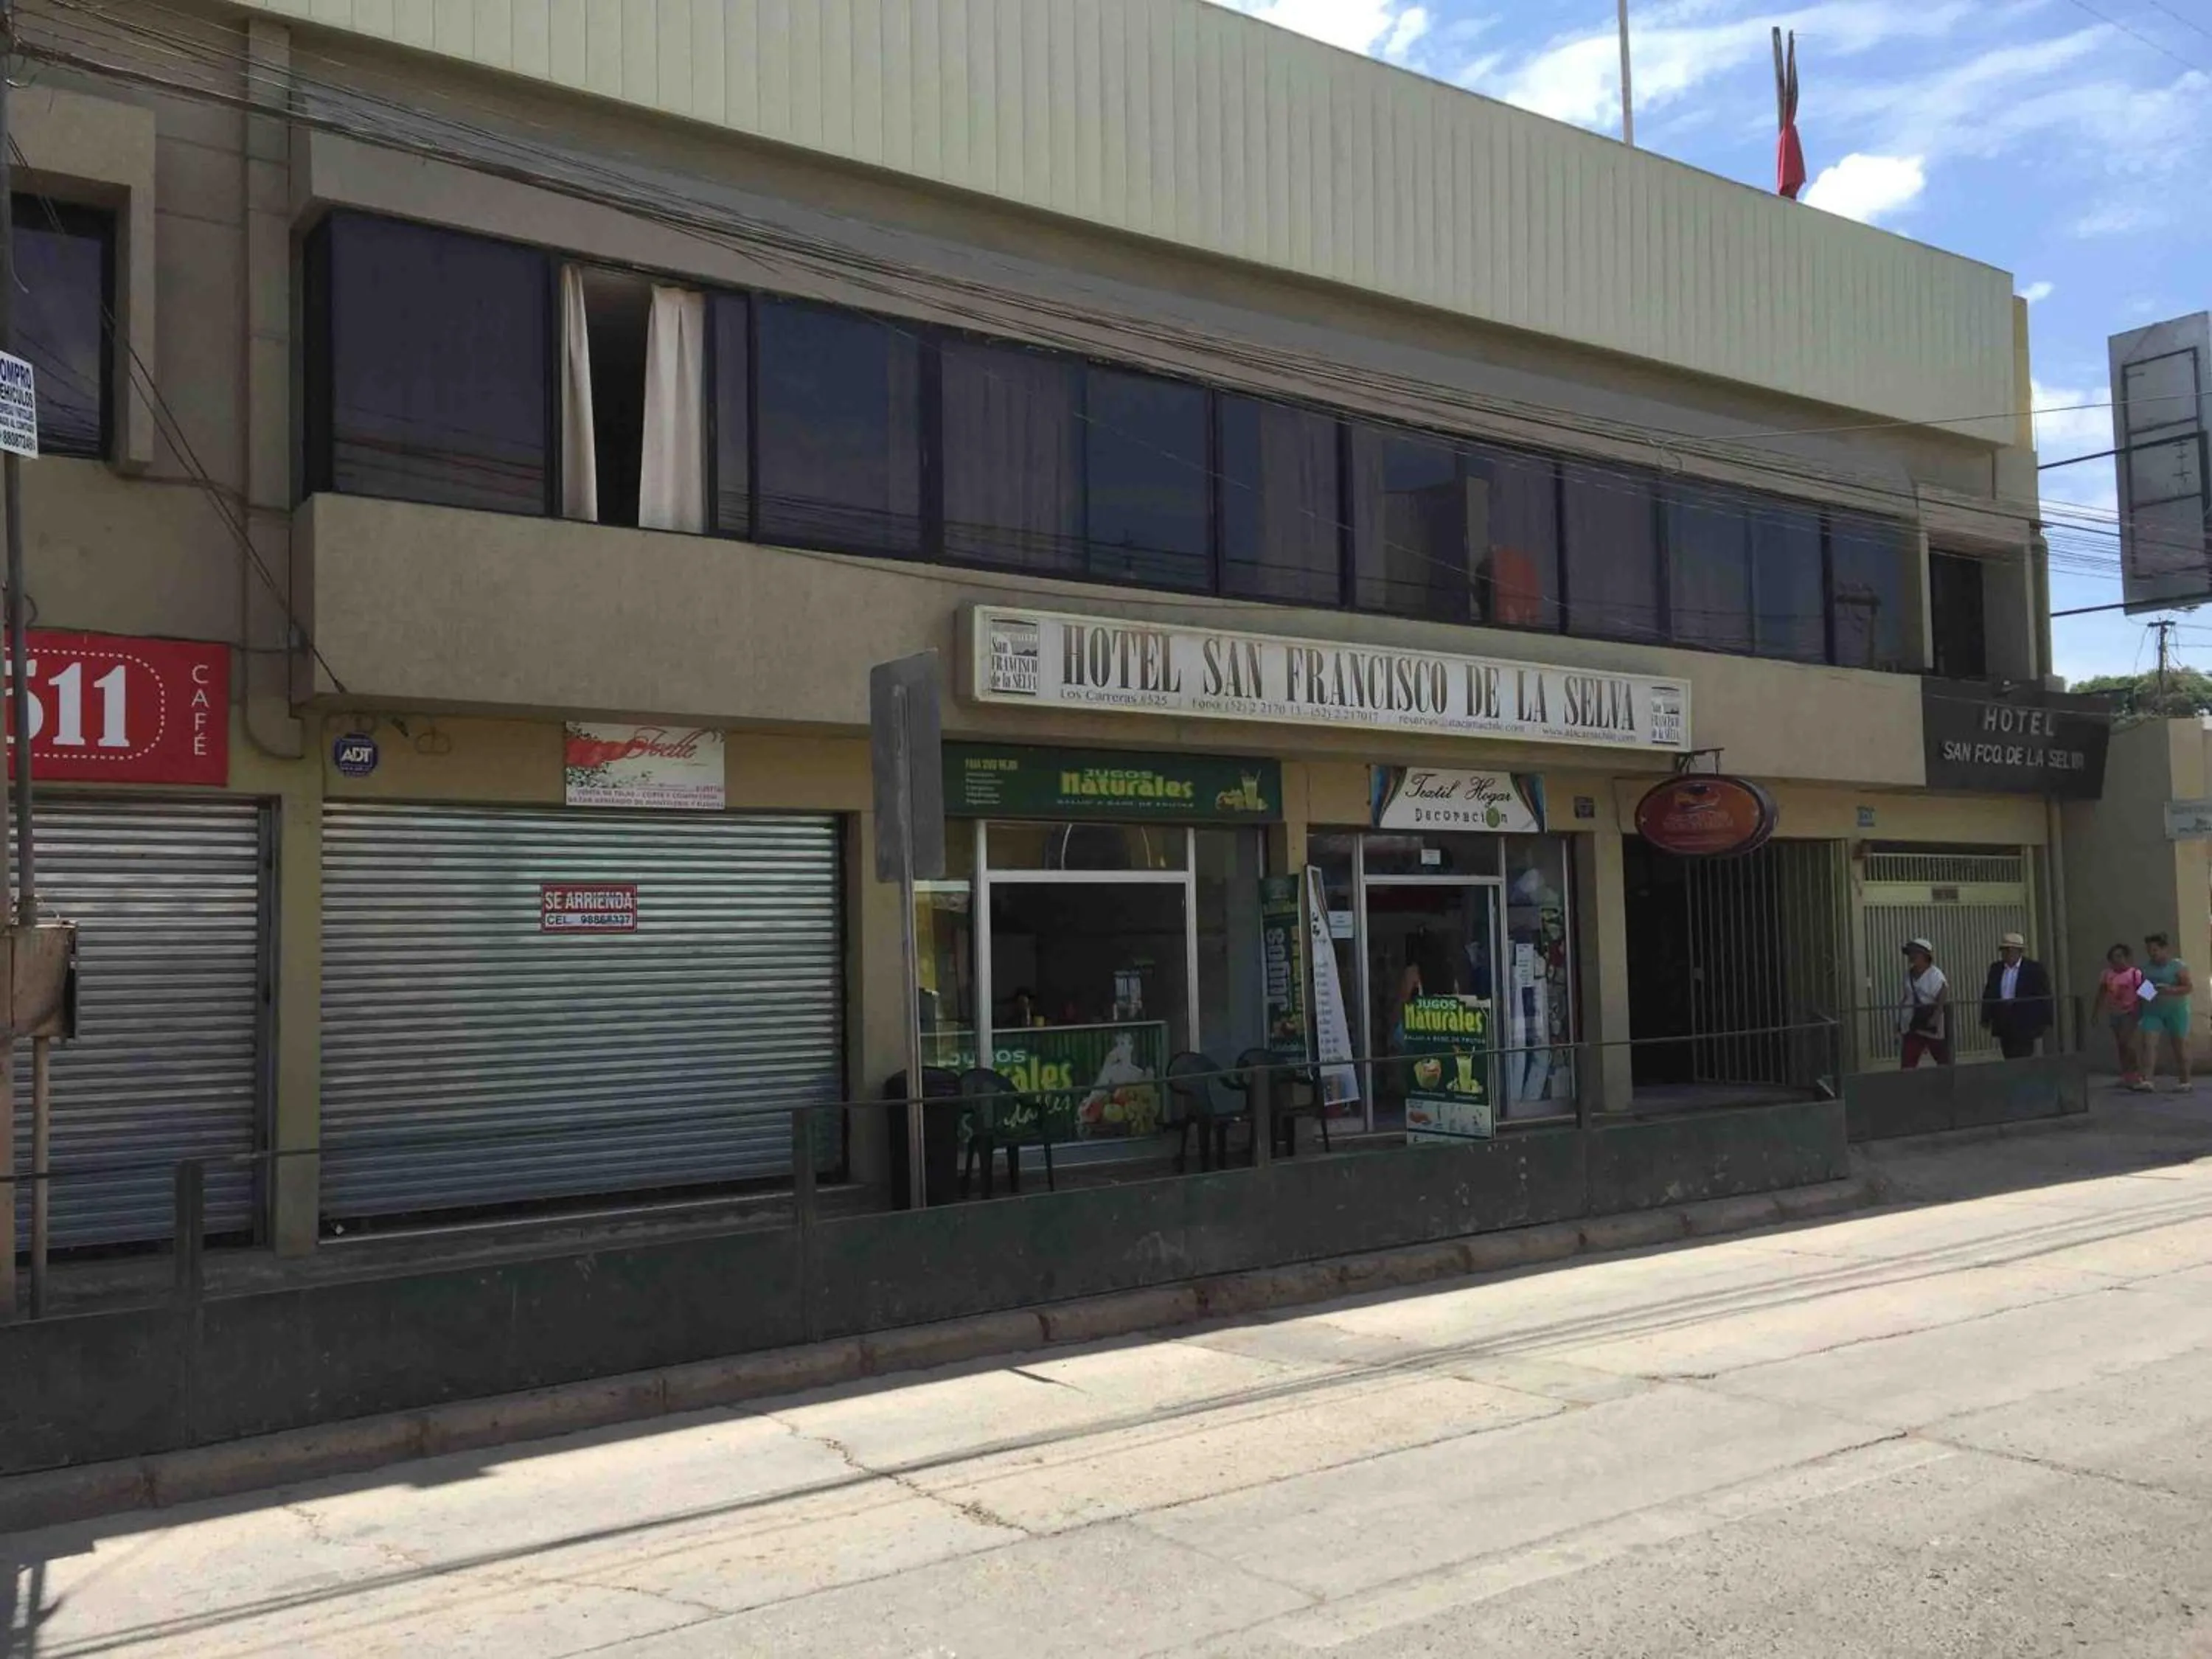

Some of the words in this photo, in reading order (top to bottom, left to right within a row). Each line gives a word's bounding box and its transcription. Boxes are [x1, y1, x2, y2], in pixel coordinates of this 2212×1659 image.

[1062, 624, 1180, 693] HOTEL
[1203, 637, 1263, 699] SAN
[1285, 646, 1448, 715] FRANCISCO
[1466, 664, 1500, 719] DE
[1517, 669, 1548, 723] LA
[1564, 675, 1636, 731] SELVA
[1060, 688, 1082, 699] Los
[1983, 706, 2055, 737] HOTEL
[340, 746, 372, 763] ADT
[1942, 740, 1971, 762] SAN
[2006, 745, 2023, 765] DE
[2026, 748, 2044, 768] LA
[1083, 768, 1153, 779] JUGOS
[1405, 773, 1461, 799] Textil
[1464, 776, 1512, 808] Hogar
[546, 891, 563, 909] SE
[566, 891, 632, 909] ARRIENDA
[1416, 998, 1458, 1009] JUGOS
